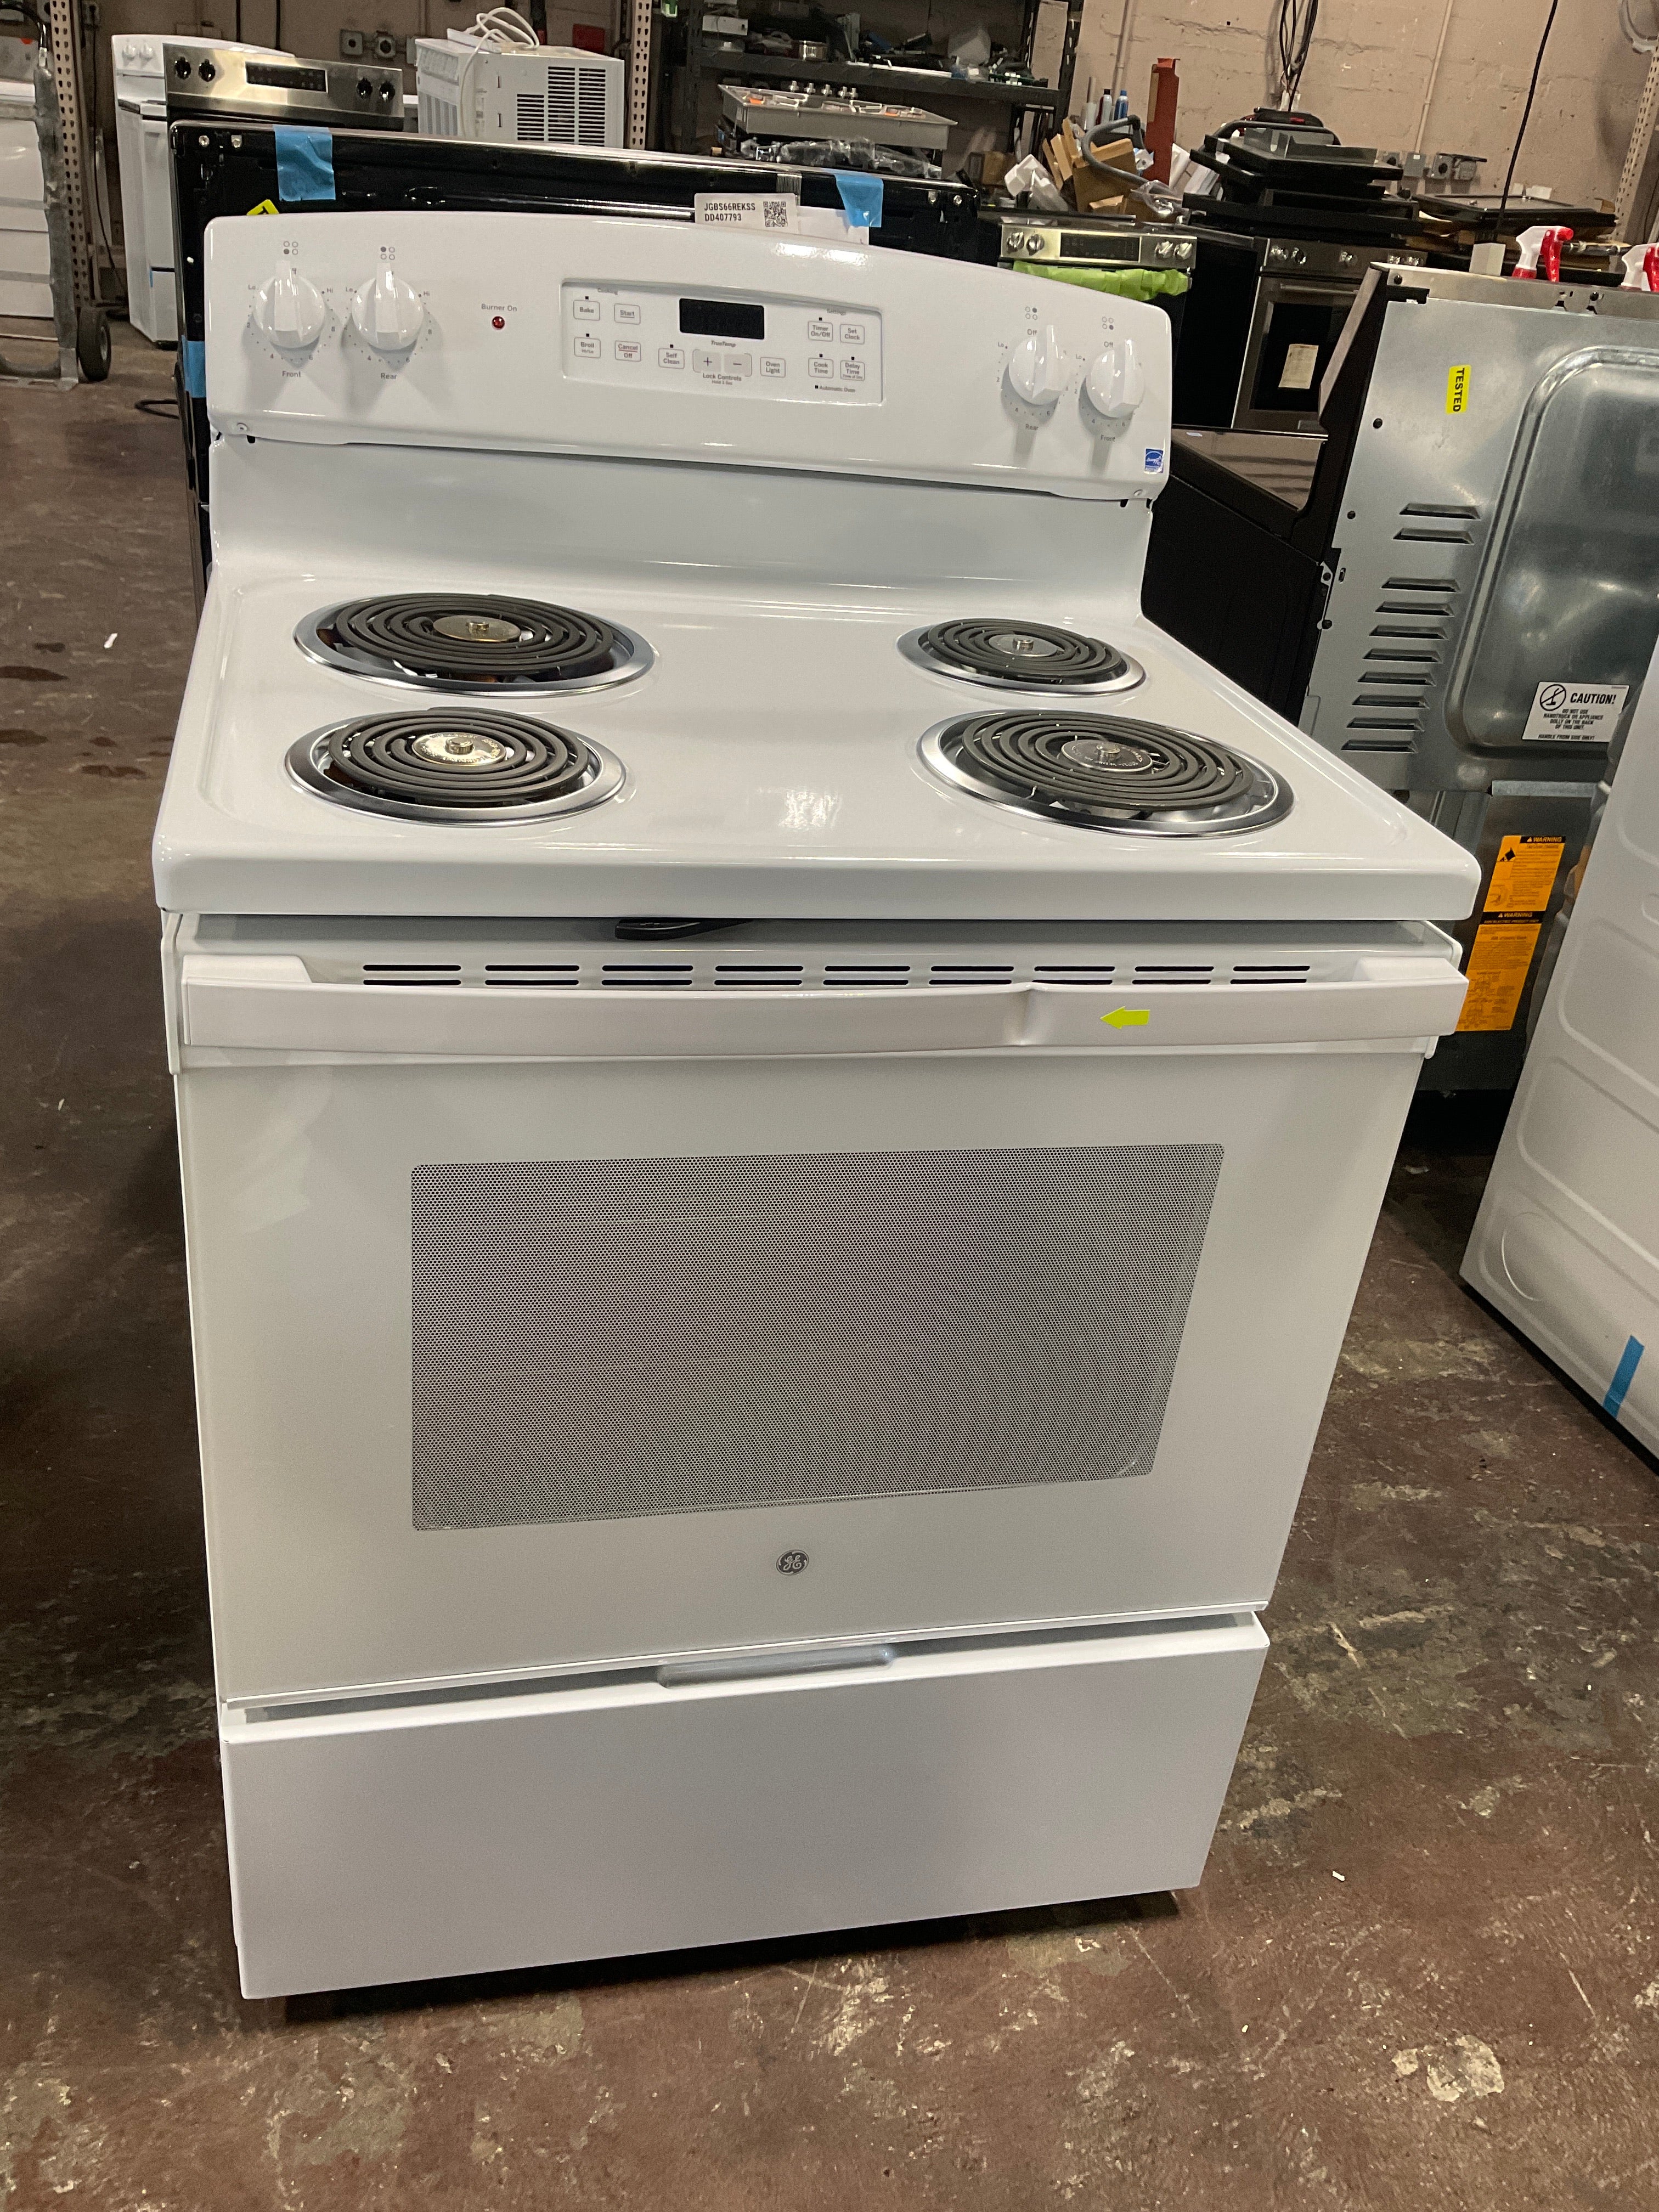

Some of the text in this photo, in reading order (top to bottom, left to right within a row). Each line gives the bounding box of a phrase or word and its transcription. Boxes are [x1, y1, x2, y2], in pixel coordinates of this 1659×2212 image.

[704, 202, 755, 211] JGBS66REKSS
[704, 213, 742, 222] DD407793
[1453, 368, 1465, 412] TESTED
[1570, 692, 1617, 704] CAUTION!
